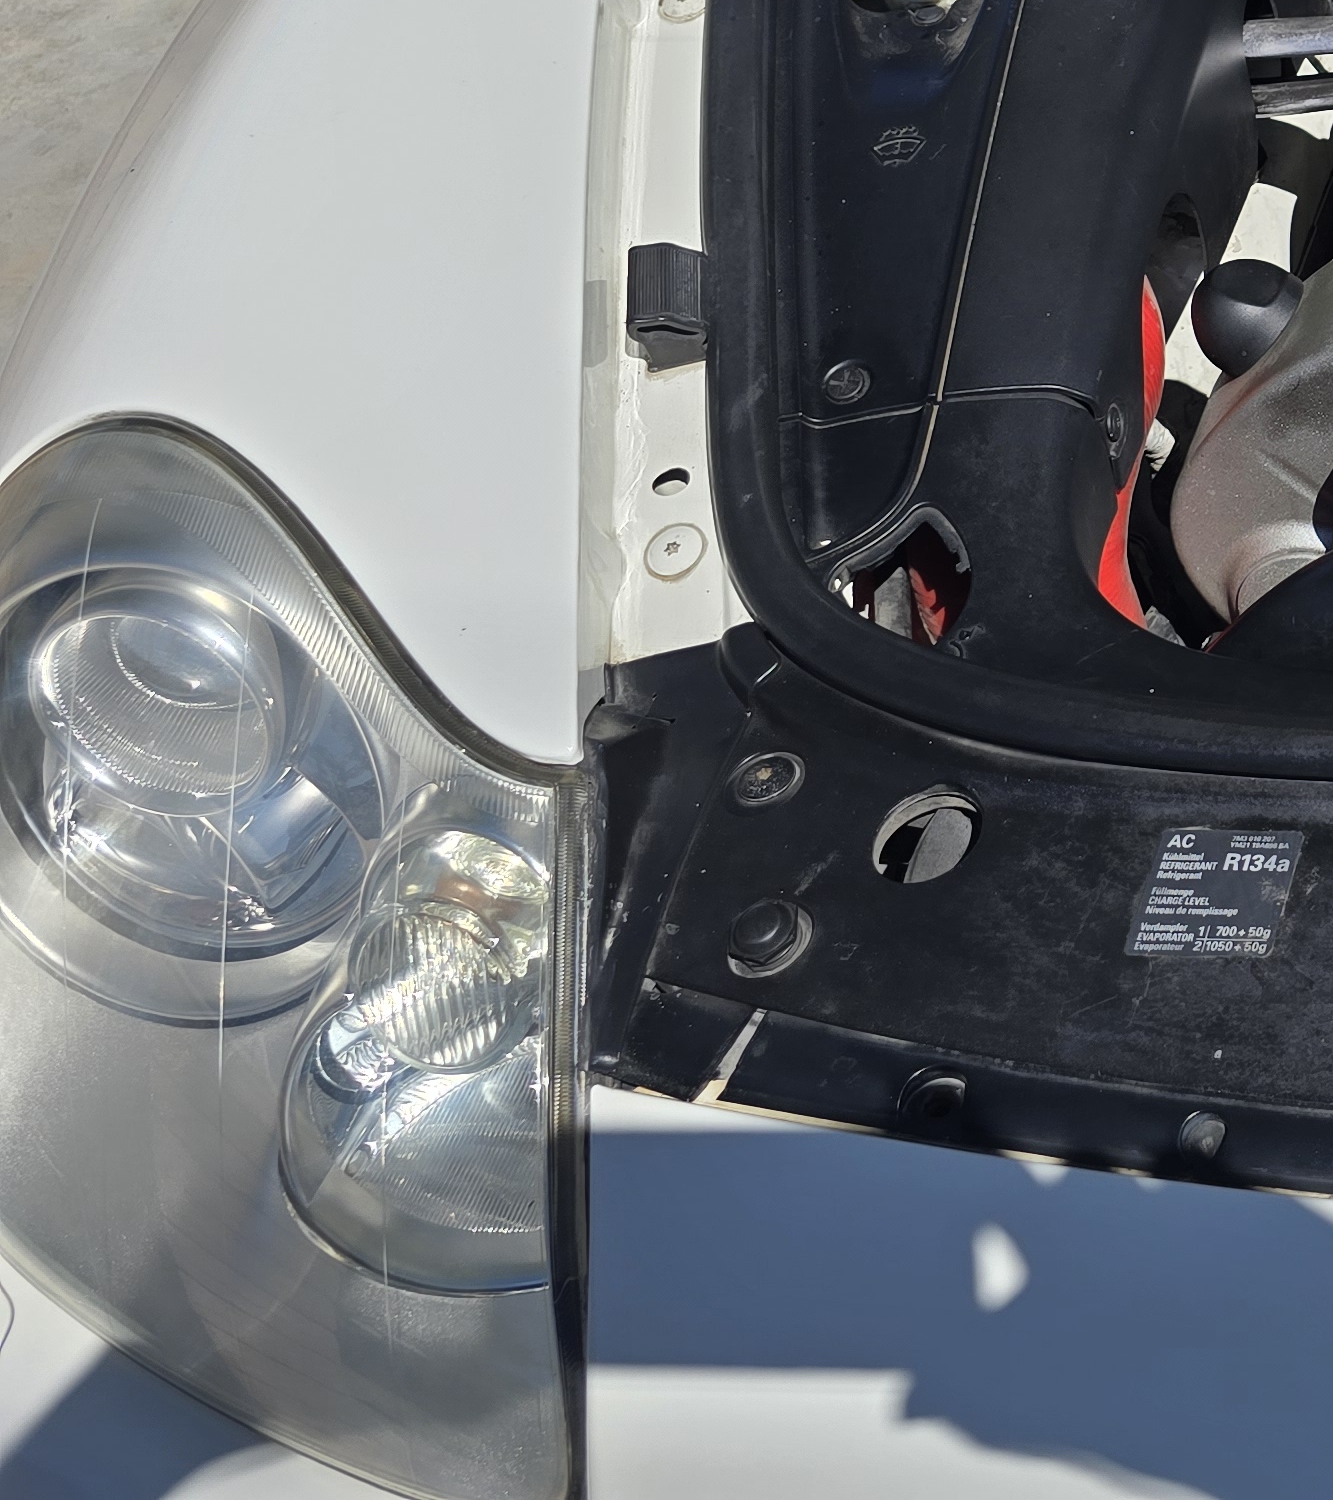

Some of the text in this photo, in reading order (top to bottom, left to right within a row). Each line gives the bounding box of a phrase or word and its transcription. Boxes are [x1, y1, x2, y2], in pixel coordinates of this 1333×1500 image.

[1167, 834, 1196, 848] AC
[1160, 853, 1290, 872] REFRIGERANT R134a
[1149, 897, 1209, 905] CHARGE LEVEL
[1145, 906, 1174, 914] Niveau
[1137, 932, 1194, 941] EVAPORATOR
[1215, 926, 1237, 936] 700
[1248, 927, 1271, 939] 50g
[1206, 941, 1232, 951] 1050
[1244, 942, 1267, 954] 50g
